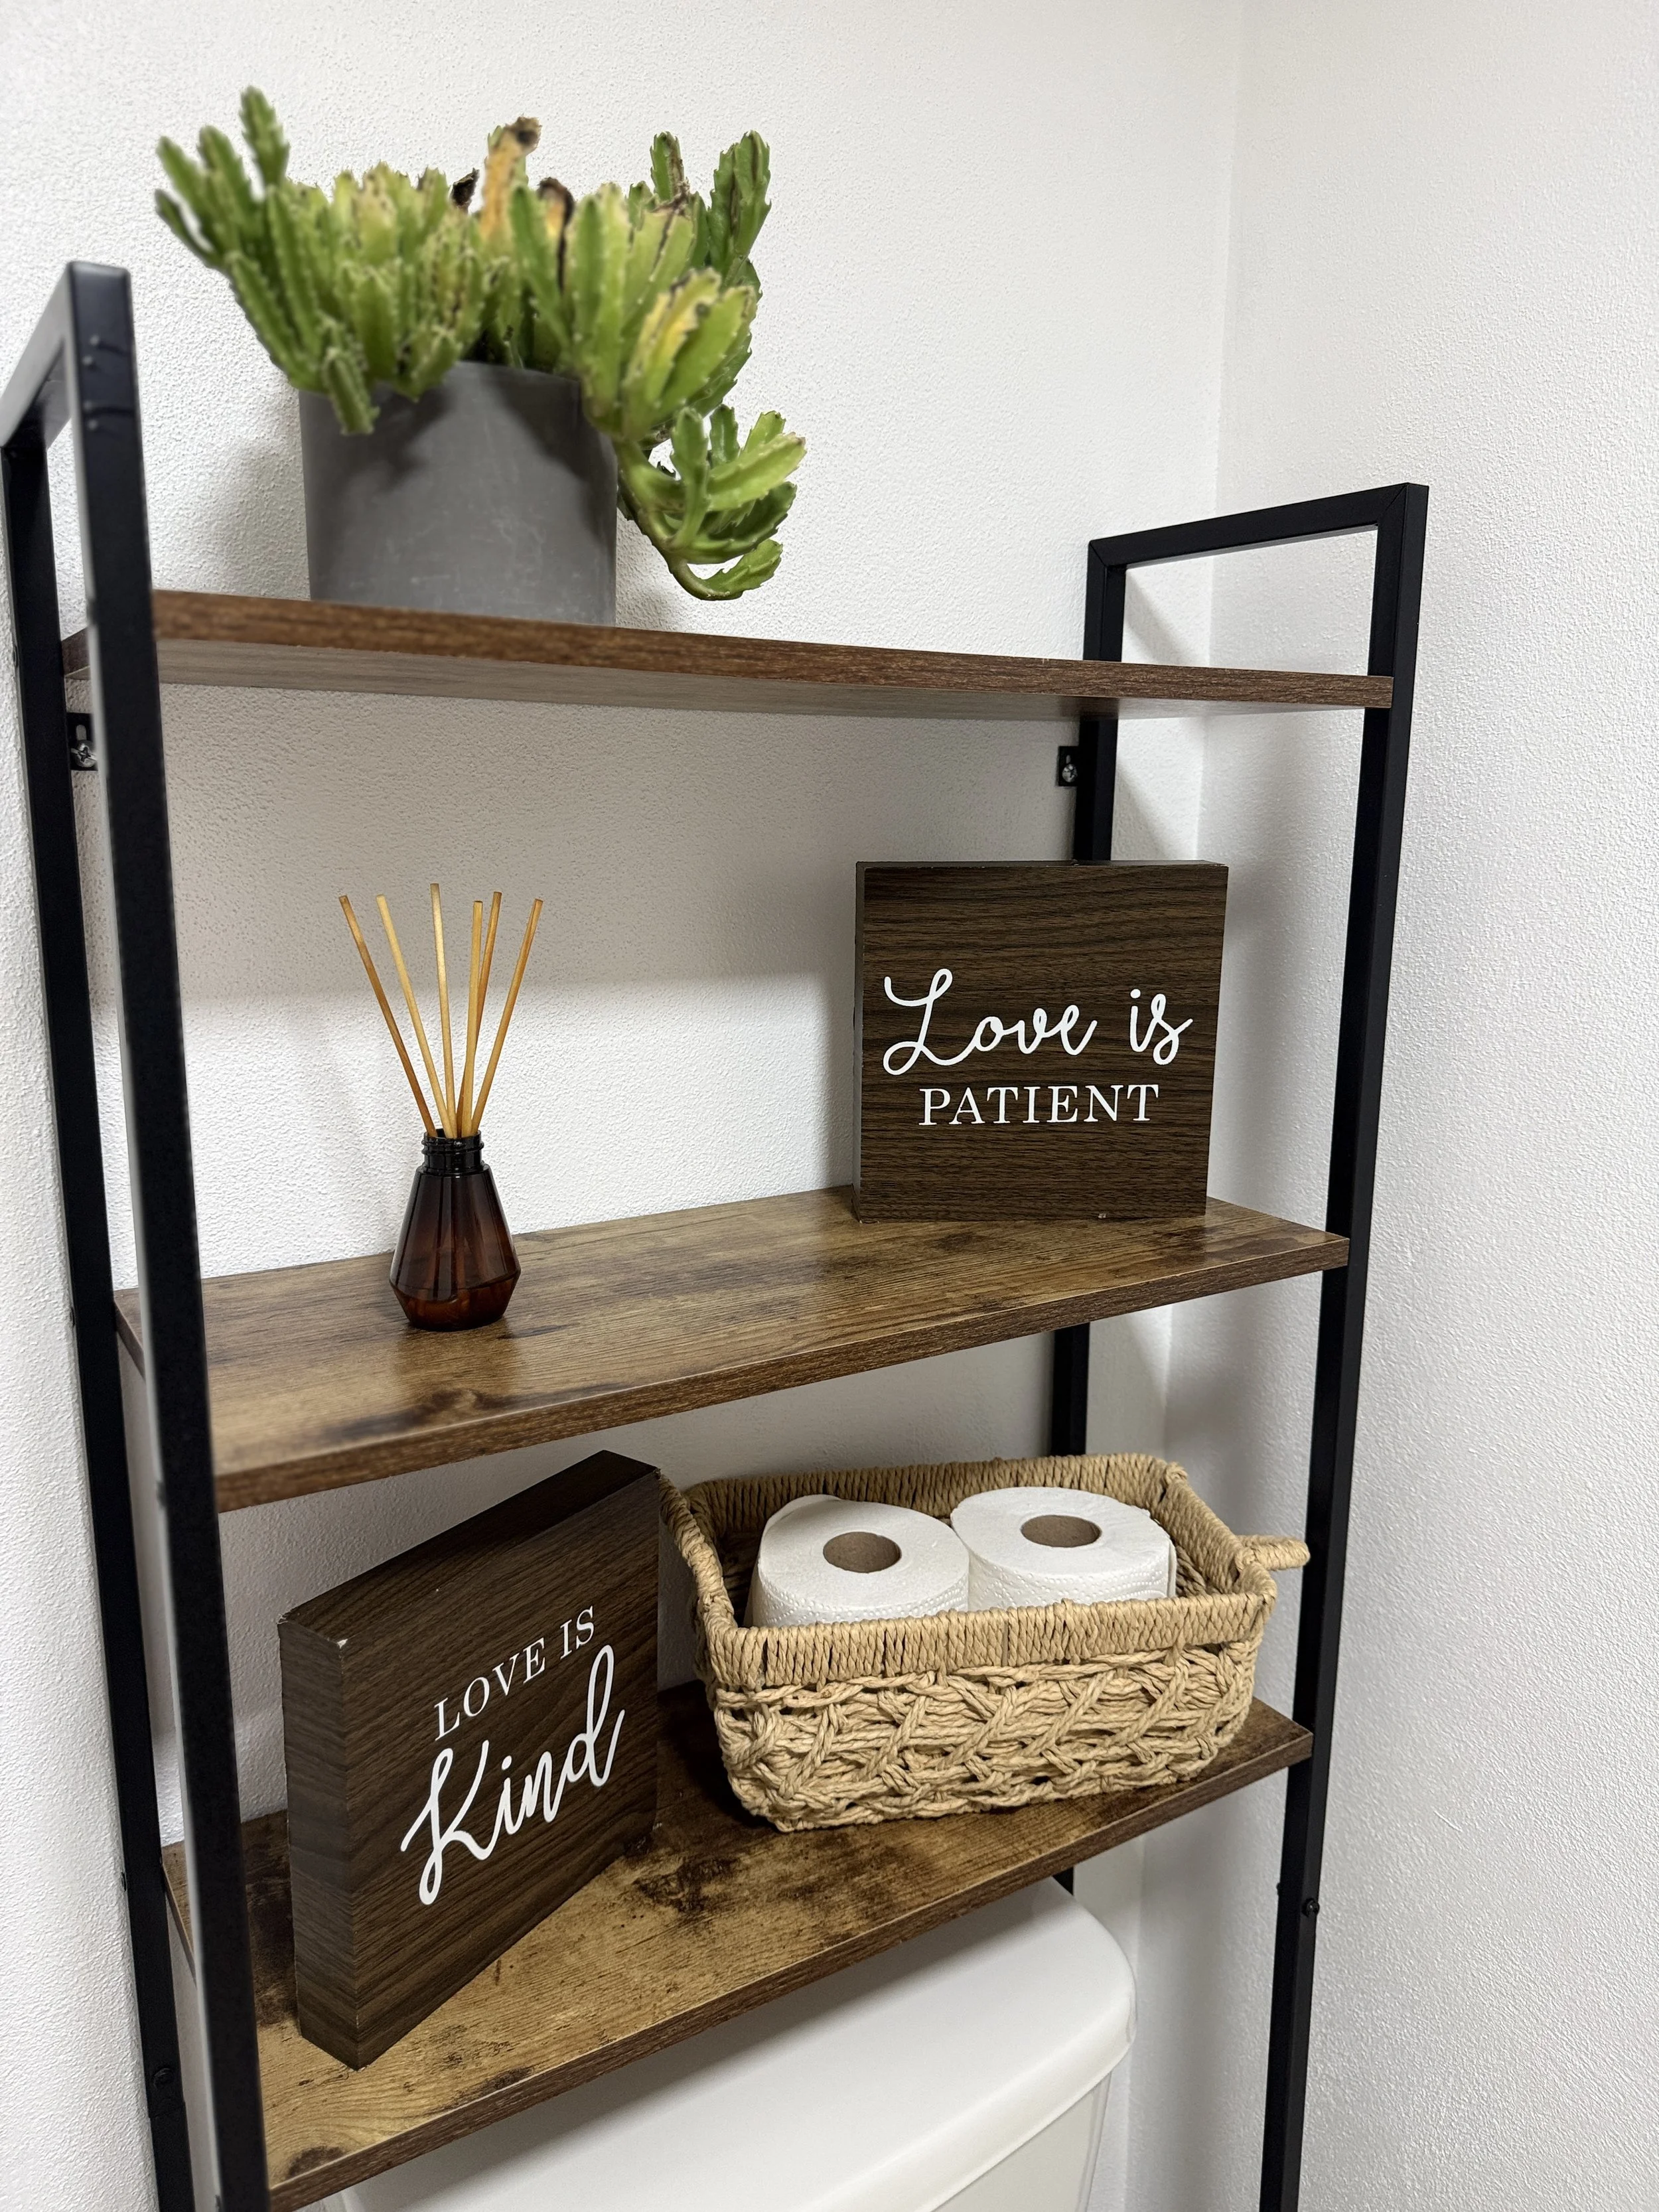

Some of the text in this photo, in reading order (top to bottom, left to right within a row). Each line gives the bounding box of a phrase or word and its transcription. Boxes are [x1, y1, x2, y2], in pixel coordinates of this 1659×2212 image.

[883, 968, 1193, 1076] Love is
[918, 1084, 1159, 1126] PATIENT
[434, 1605, 595, 1741] LOVE IS
[400, 1645, 625, 1905] Kind
